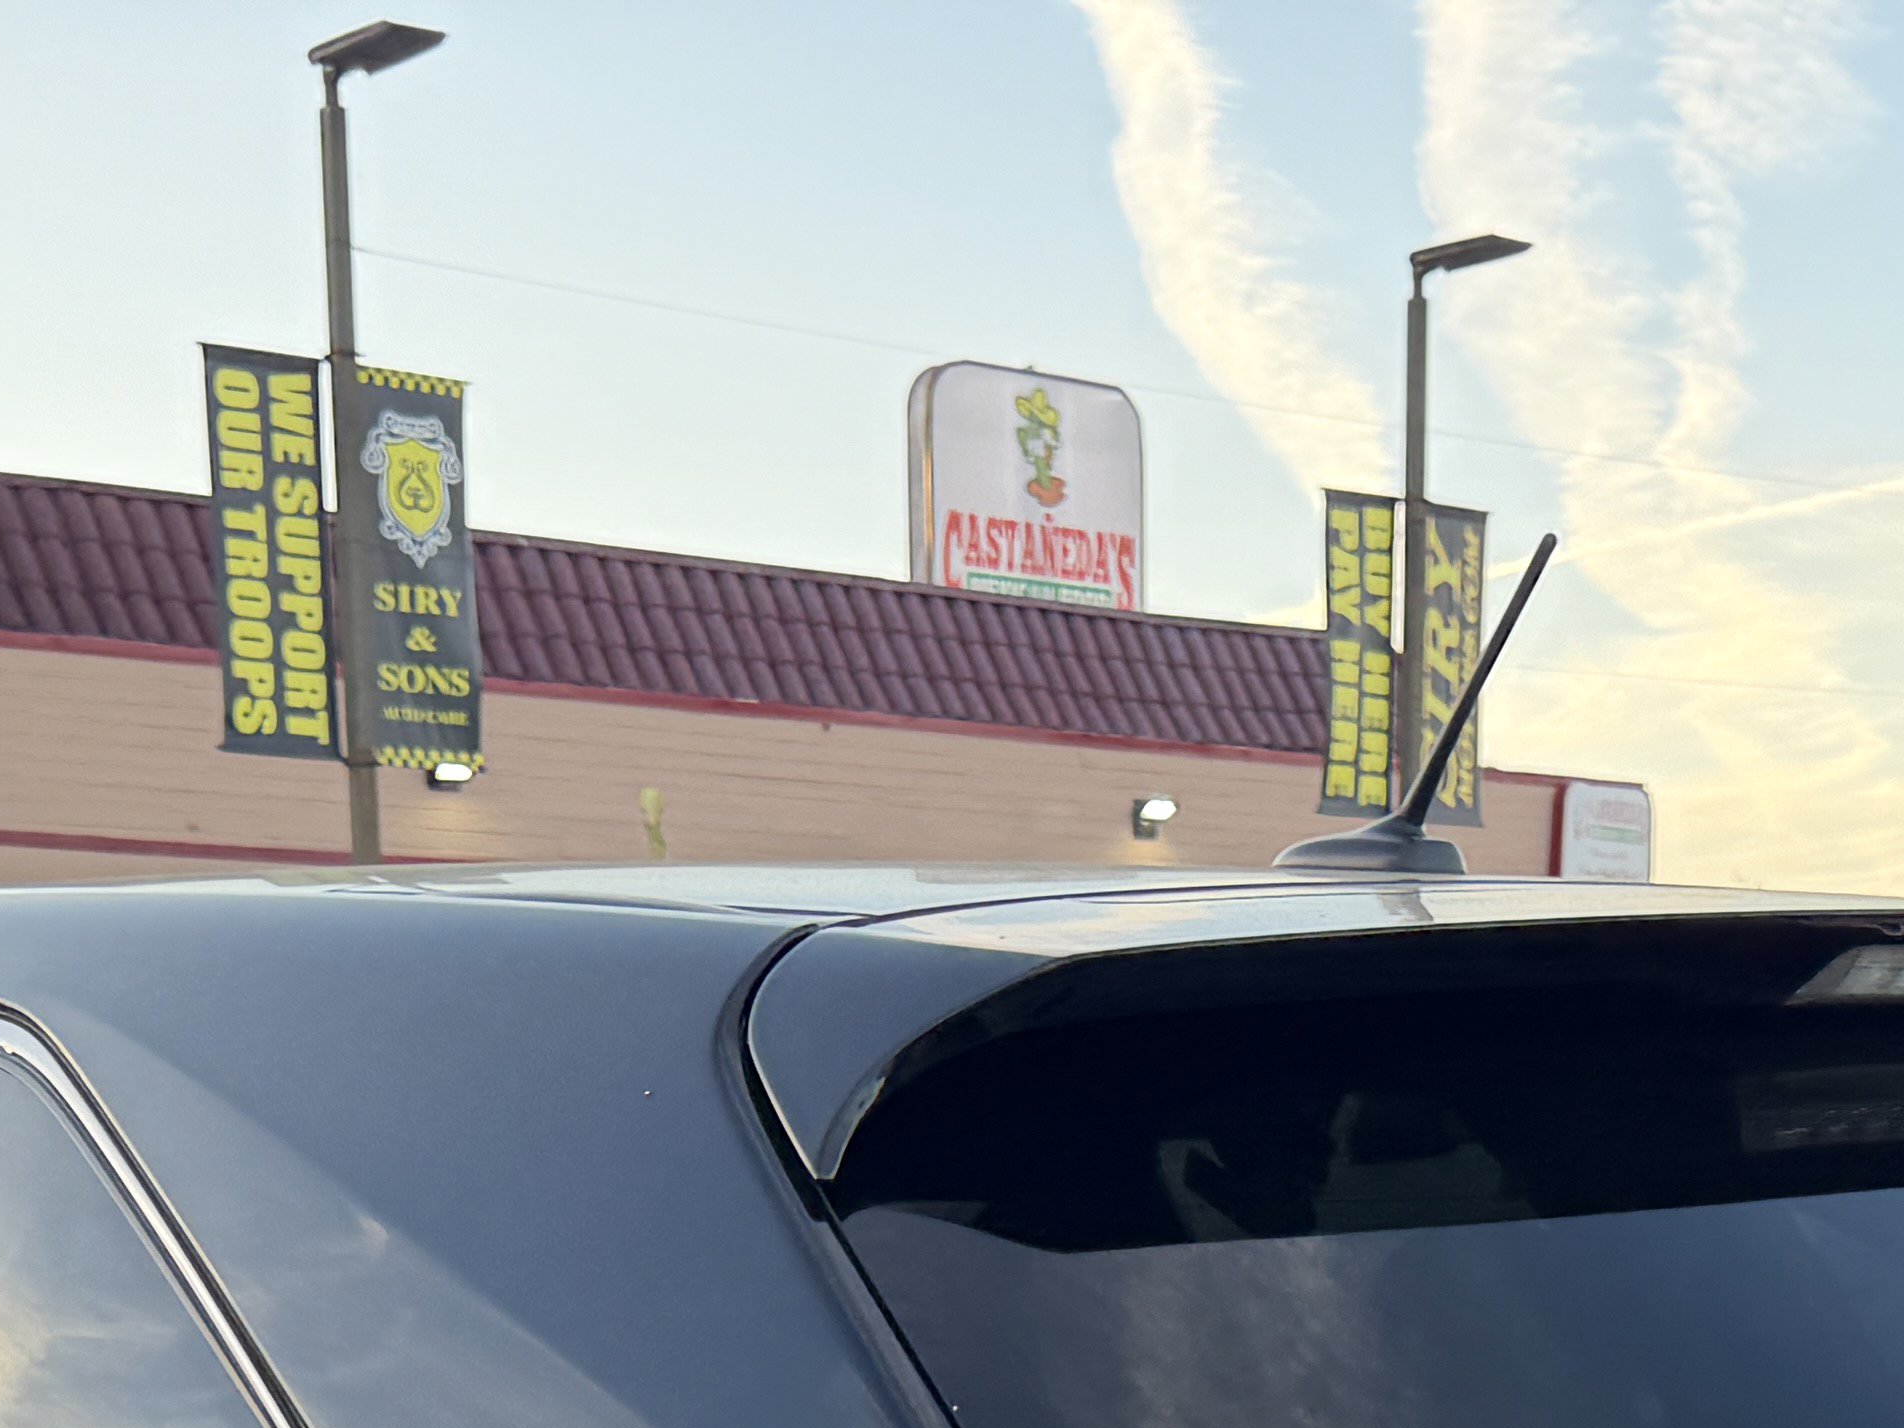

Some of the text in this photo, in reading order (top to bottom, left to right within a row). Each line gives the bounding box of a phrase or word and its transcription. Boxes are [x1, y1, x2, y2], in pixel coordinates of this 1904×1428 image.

[213, 368, 278, 736] OUR TROOPS
[267, 373, 331, 746] WE SUPPORT
[373, 581, 462, 618] SIRY
[376, 662, 471, 697] SONS
[405, 625, 438, 652] &
[1325, 509, 1362, 799] PAY HERE
[1358, 507, 1392, 807] BUY HERE
